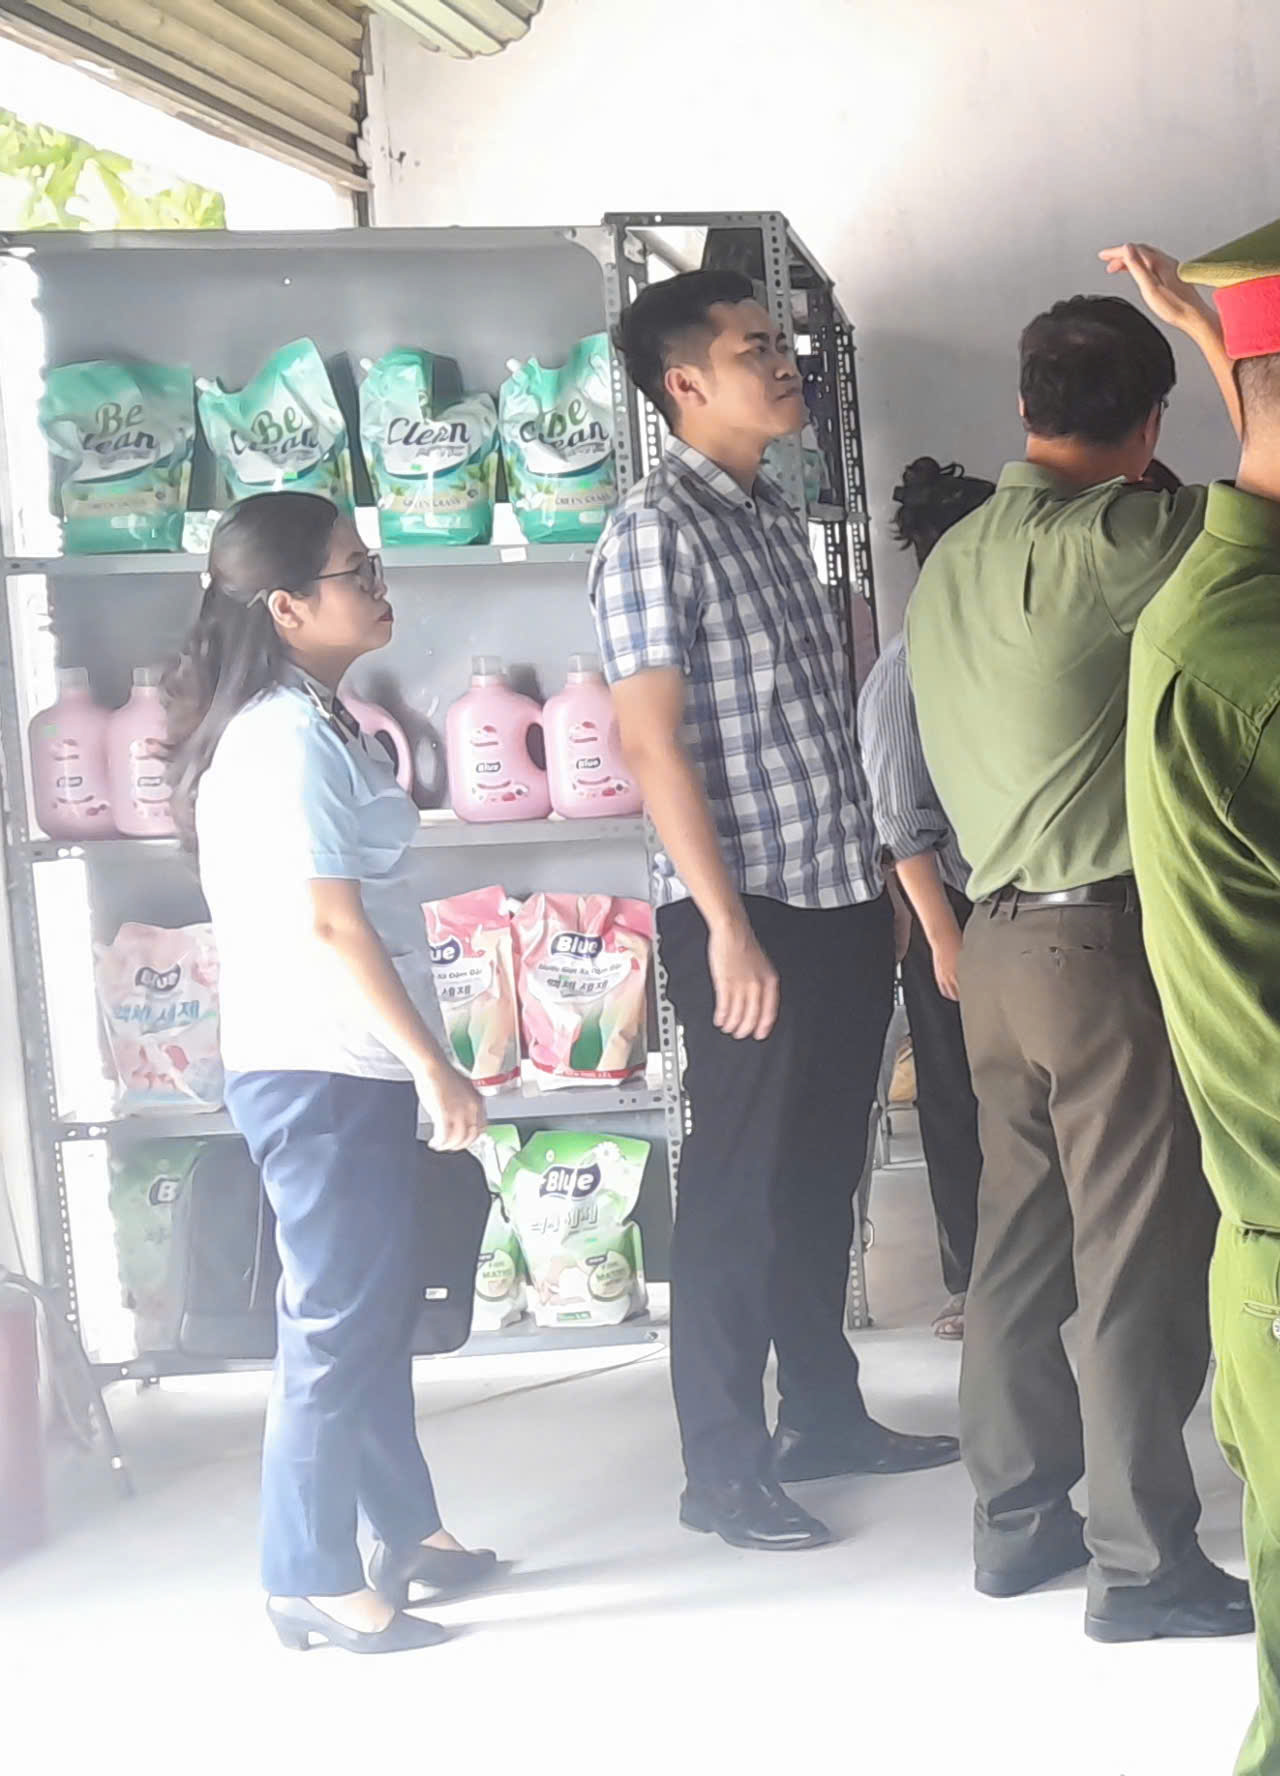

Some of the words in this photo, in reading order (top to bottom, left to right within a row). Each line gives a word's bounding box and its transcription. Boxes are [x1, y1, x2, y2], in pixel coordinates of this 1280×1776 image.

[96, 402, 145, 438] Be
[251, 406, 303, 445] Be
[430, 944, 456, 962] ue
[556, 933, 598, 956] Blue
[545, 1166, 595, 1193] Blue
